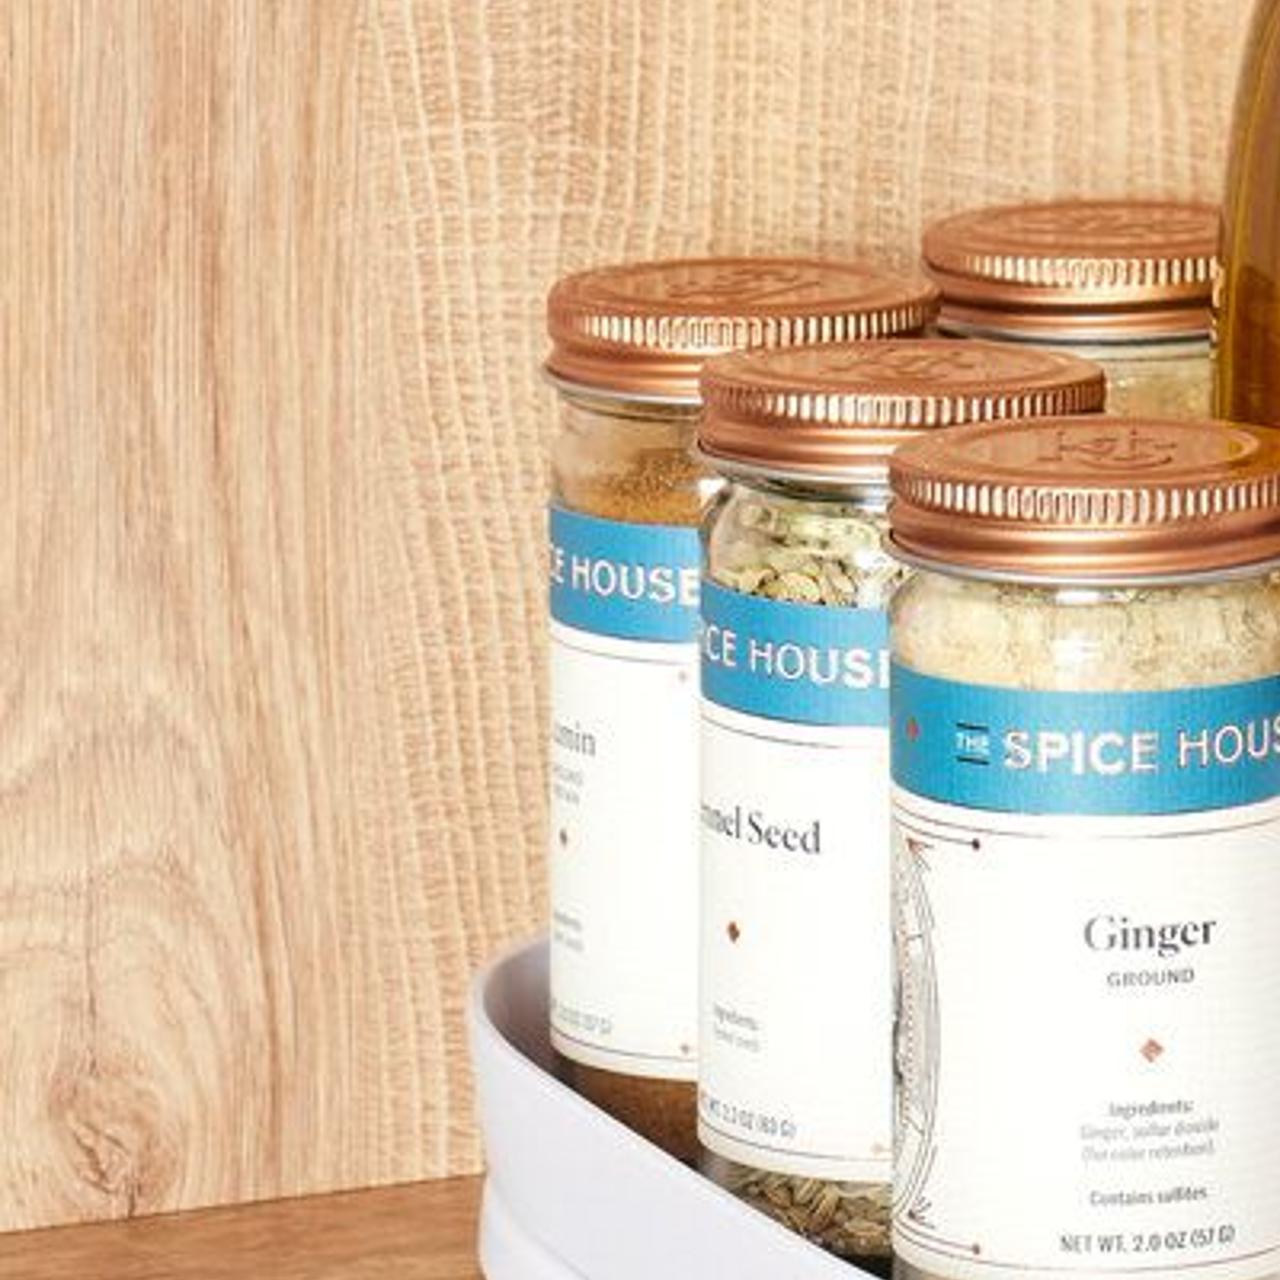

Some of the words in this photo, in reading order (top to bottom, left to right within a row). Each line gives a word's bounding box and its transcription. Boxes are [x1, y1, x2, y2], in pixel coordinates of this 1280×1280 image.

[956, 733, 989, 754] THE
[1004, 731, 1160, 776] SPICE
[748, 811, 821, 855] Seed
[1083, 915, 1217, 958] Ginger
[1106, 968, 1195, 988] GROUND
[1060, 1234, 1092, 1254] NET
[1132, 1233, 1162, 1252] 2.0
[1165, 1231, 1188, 1250] OZ
